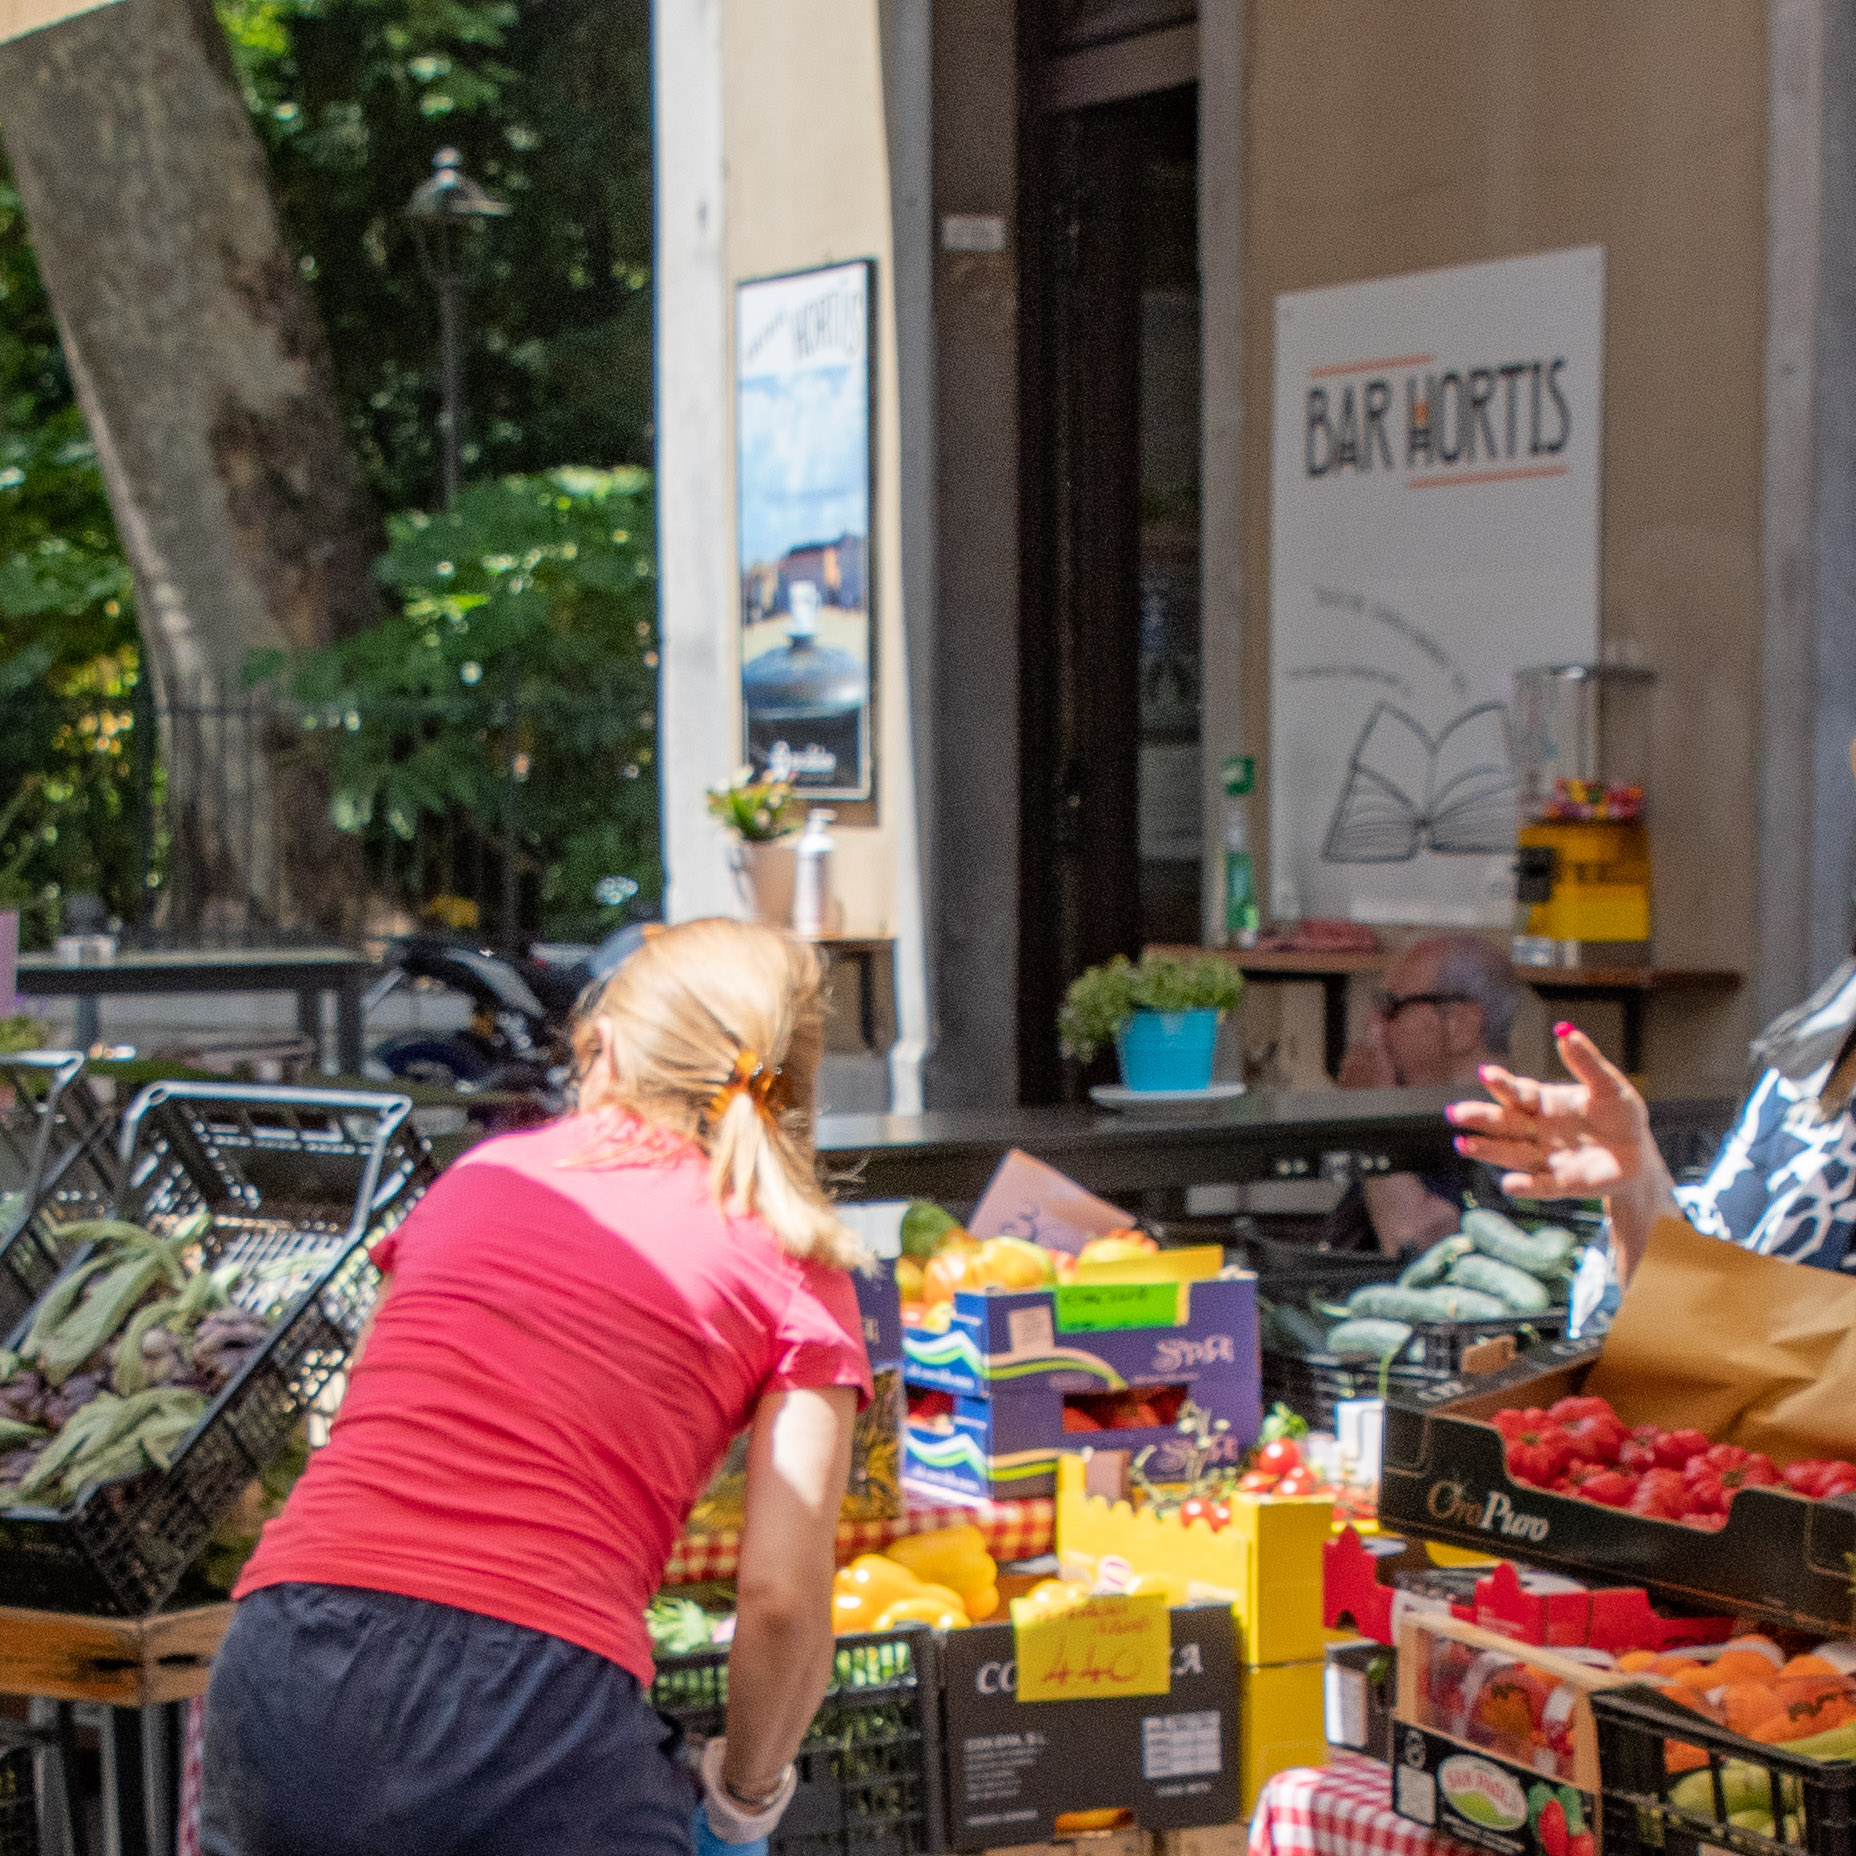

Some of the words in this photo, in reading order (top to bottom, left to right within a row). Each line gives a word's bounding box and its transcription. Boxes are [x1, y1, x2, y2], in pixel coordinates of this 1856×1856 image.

[1306, 377, 1393, 479] BAR
[1406, 355, 1572, 468] HORTIS
[1479, 1490, 1550, 1542] Puro
